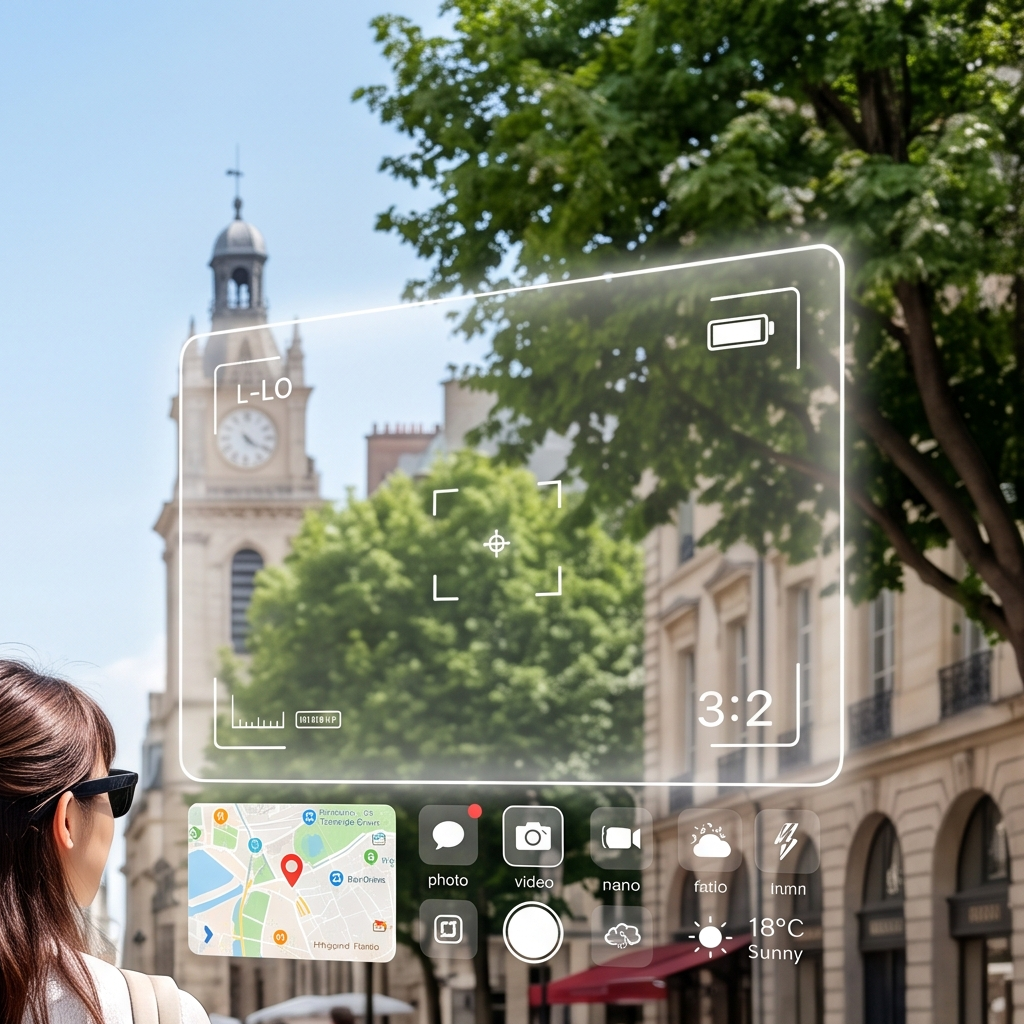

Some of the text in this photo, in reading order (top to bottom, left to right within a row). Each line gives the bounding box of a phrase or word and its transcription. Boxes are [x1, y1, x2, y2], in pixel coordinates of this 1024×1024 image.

[698, 689, 773, 728] 3:2
[428, 874, 469, 888] photo
[514, 875, 554, 888] video
[602, 880, 641, 891] nano
[694, 879, 728, 893] fatio
[749, 917, 804, 938] 18°C
[748, 944, 803, 965] Sunny
